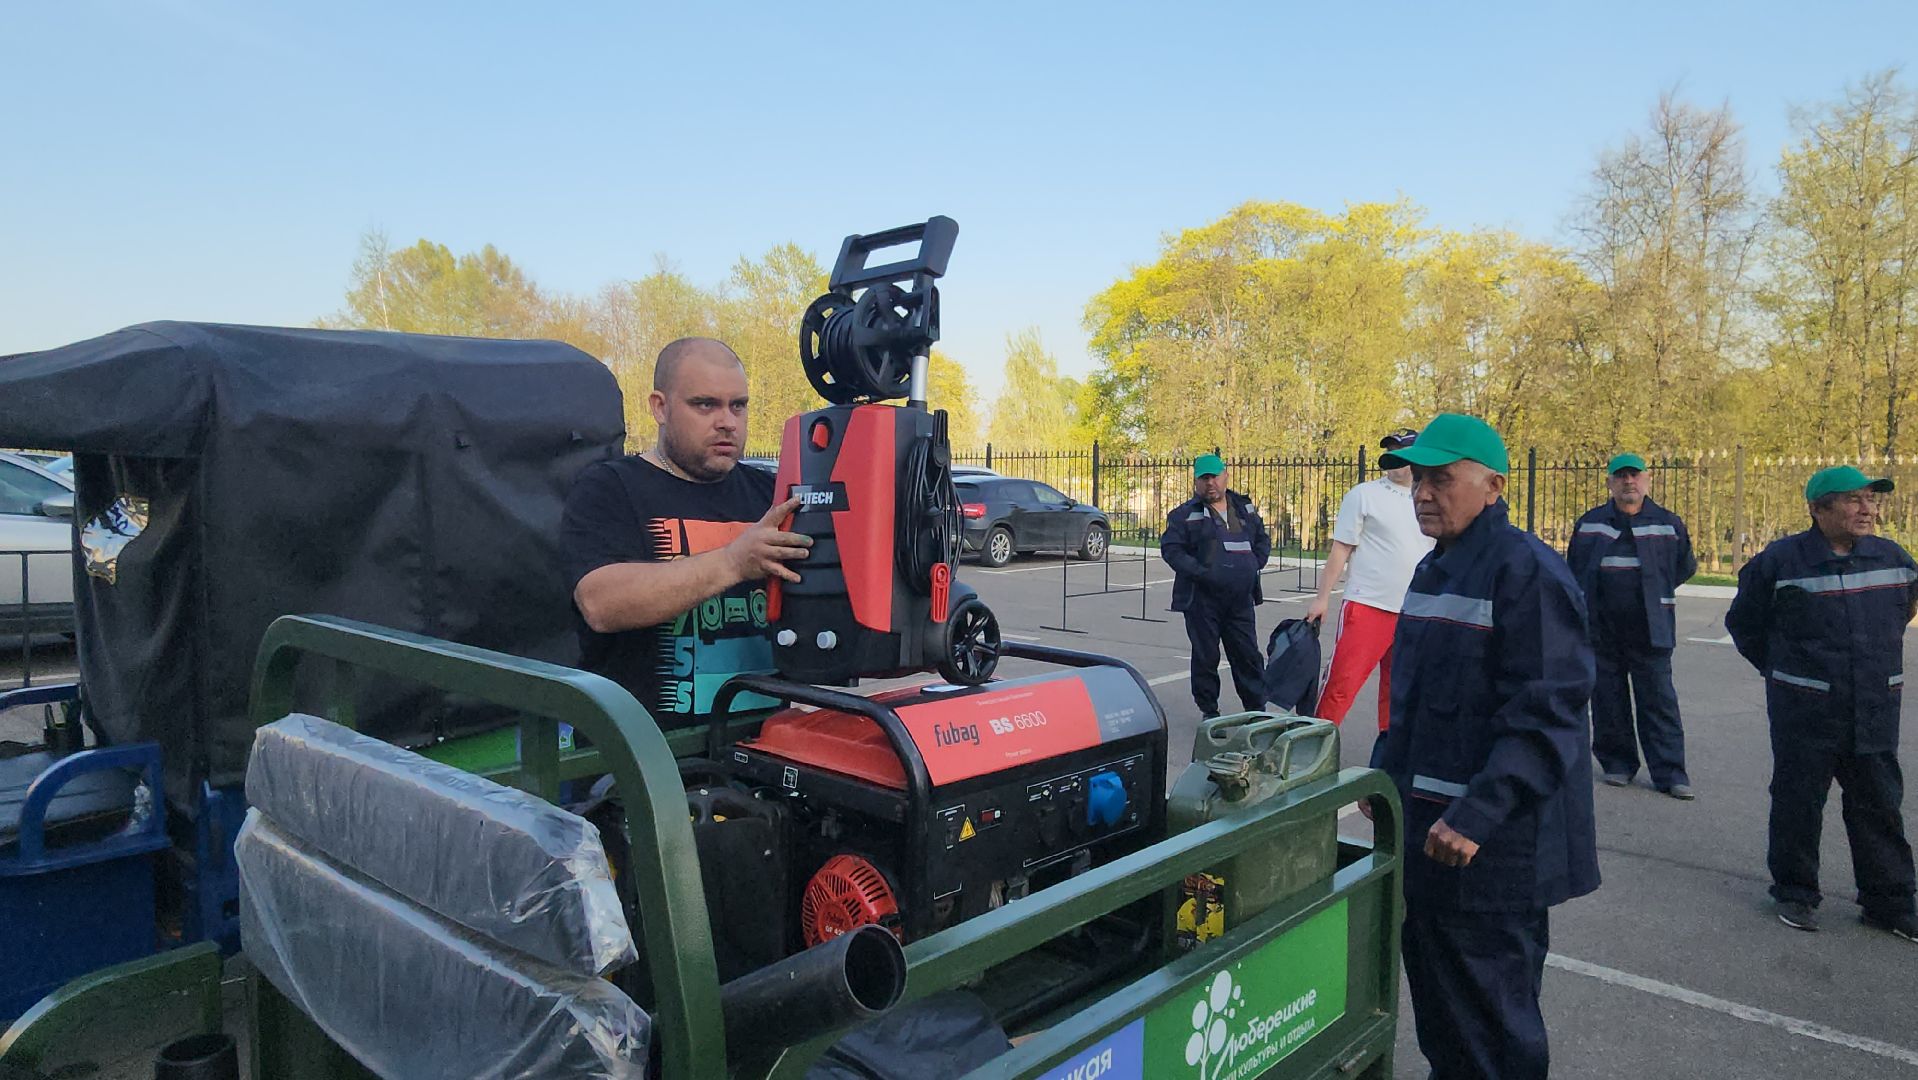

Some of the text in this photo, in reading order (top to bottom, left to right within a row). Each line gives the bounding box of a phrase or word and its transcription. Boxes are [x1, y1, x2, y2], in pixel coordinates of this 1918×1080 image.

[934, 710, 1047, 748] fubag BS 6600
[1211, 988, 1317, 1080] Люберецкие
[1238, 1041, 1279, 1078] КУЛЬТУРЫ
